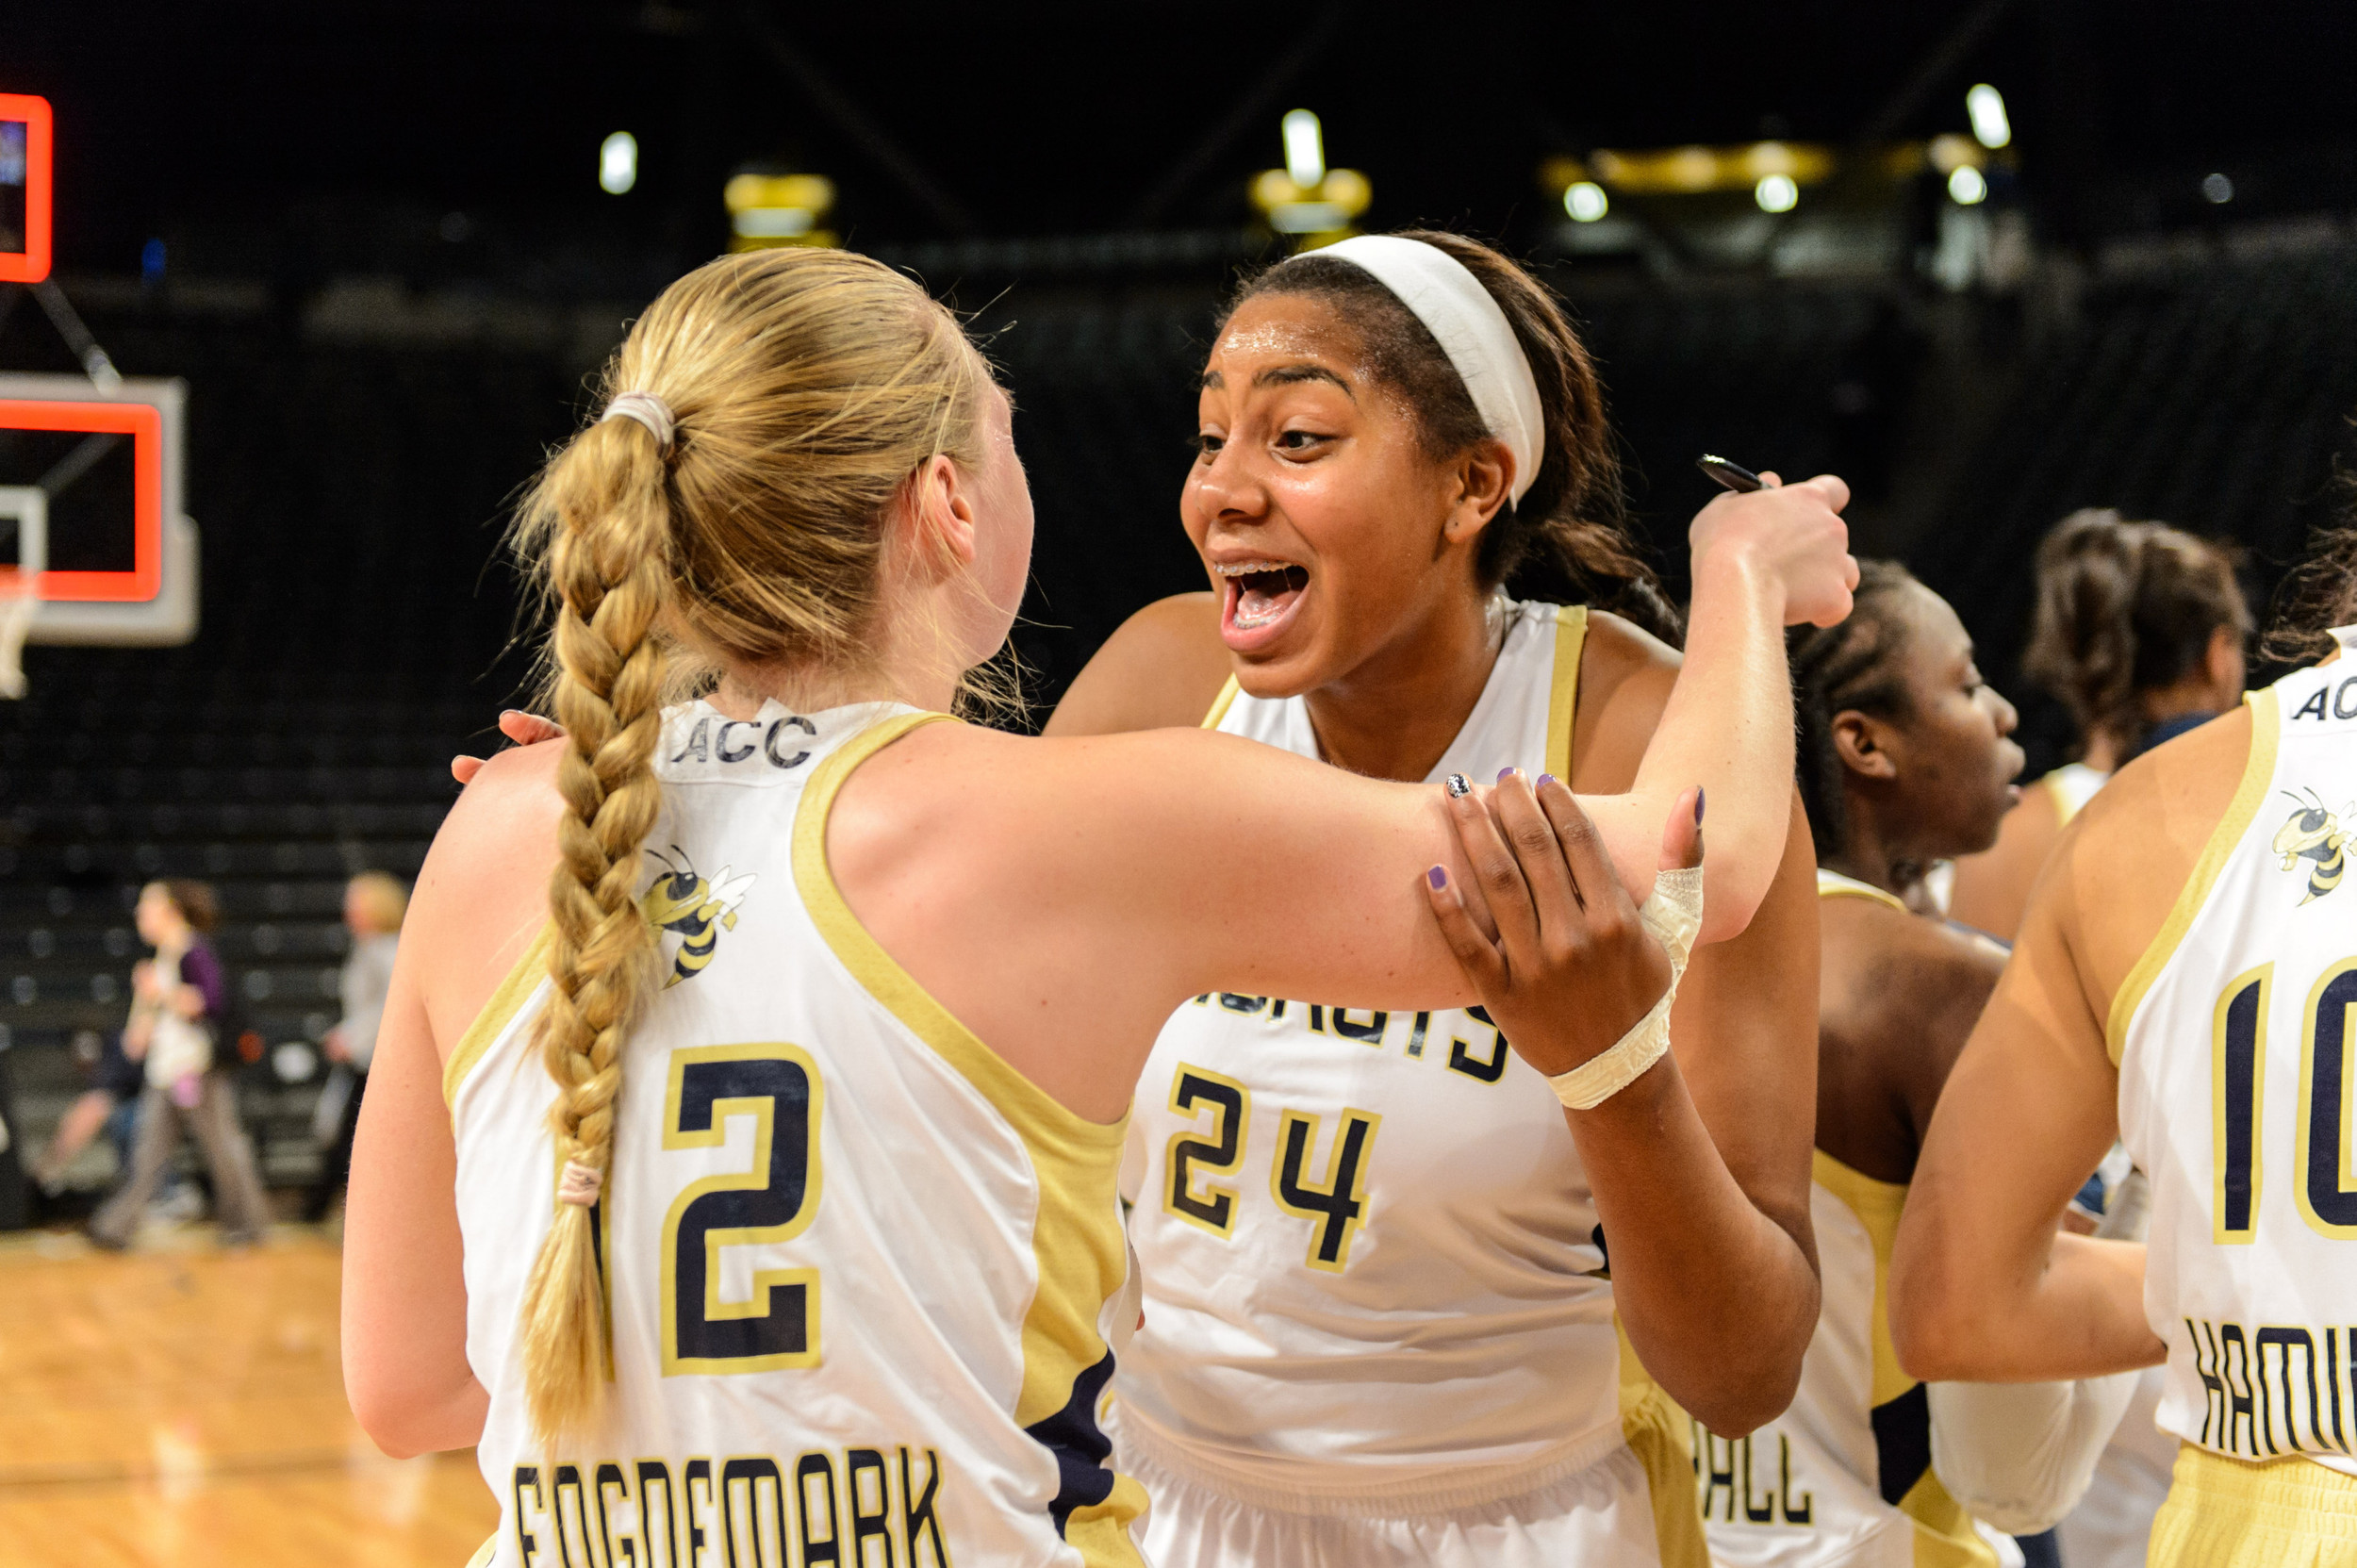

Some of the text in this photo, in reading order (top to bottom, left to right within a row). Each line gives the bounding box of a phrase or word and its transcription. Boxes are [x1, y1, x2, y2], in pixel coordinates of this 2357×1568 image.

[670, 716, 817, 769] ACC
[660, 1041, 826, 1378] 2
[1165, 1061, 1383, 1275] 24
[2184, 1315, 2357, 1458] HAMI
